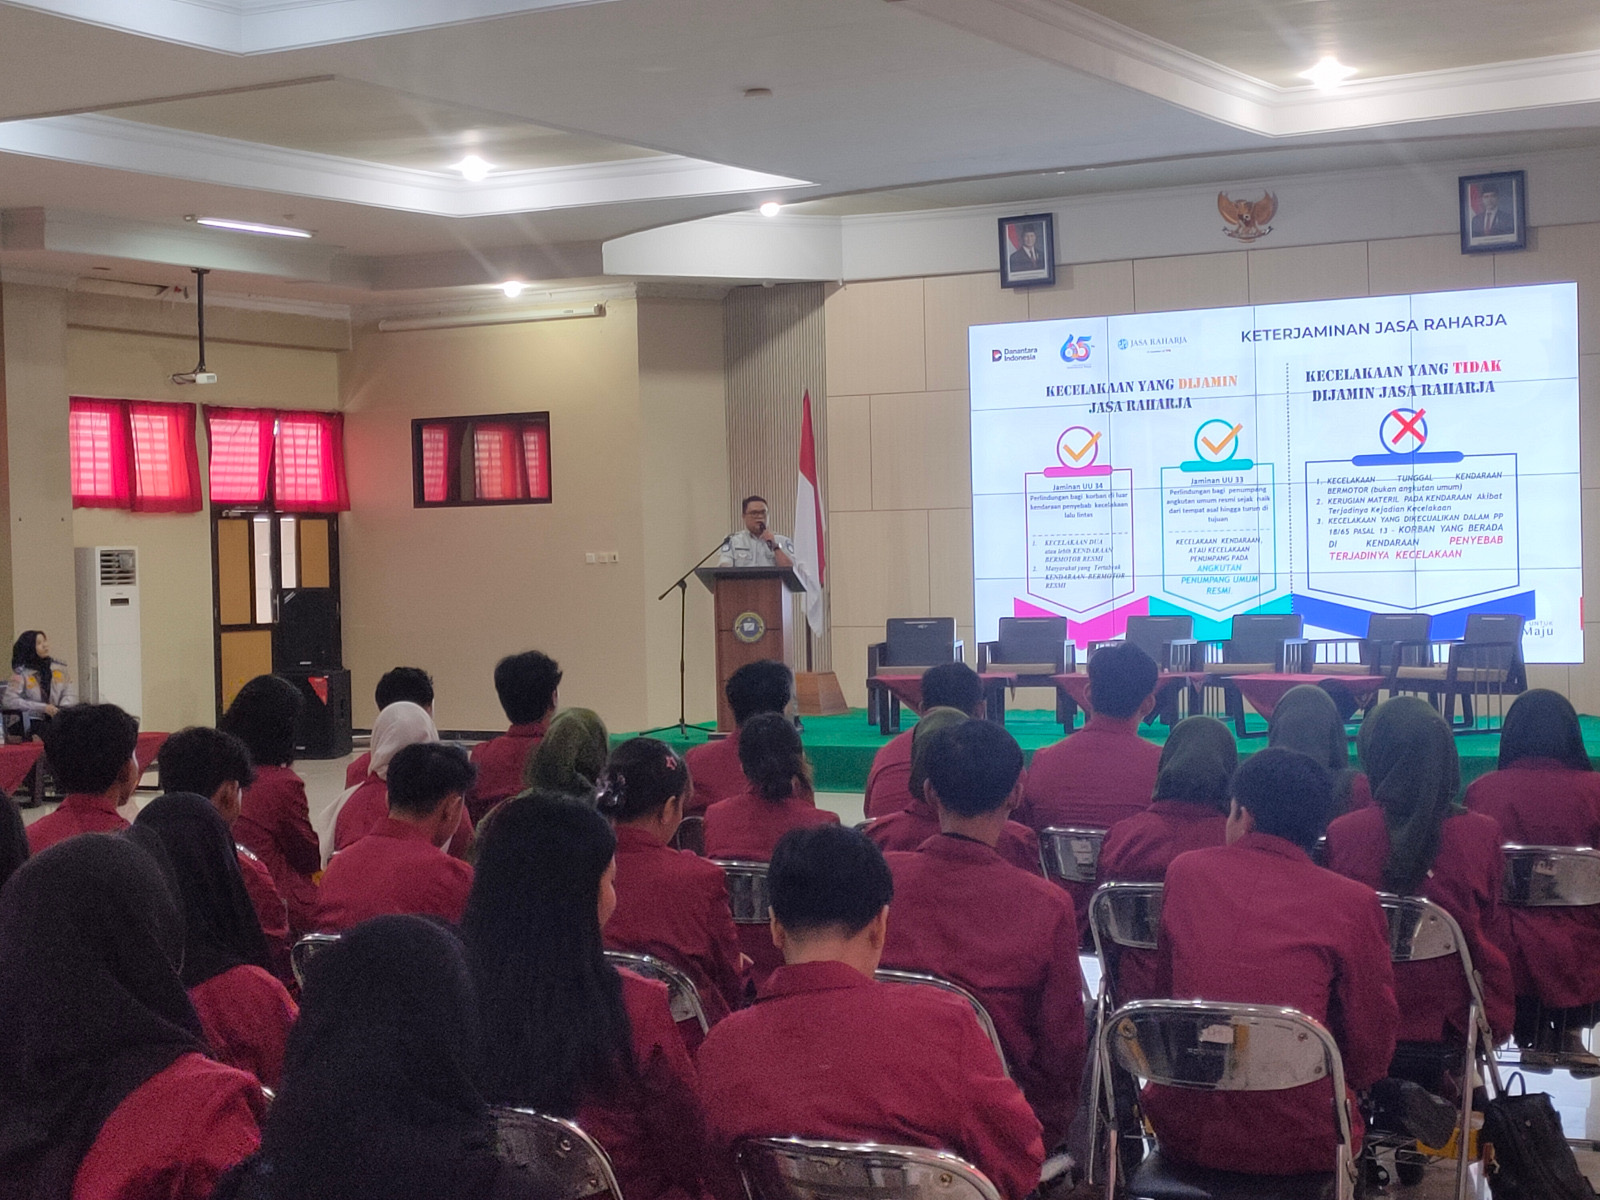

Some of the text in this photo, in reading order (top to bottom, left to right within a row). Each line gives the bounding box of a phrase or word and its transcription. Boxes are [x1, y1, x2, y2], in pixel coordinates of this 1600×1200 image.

[1241, 314, 1507, 343] KETERJAMINAN JASA RAHARJA
[1130, 336, 1188, 348] JASA RAHARJA
[1306, 360, 1501, 382] KECELAKAAN YANG TIDAK
[1046, 375, 1238, 397] KECELAKAAN YANG DIJAMIN
[1312, 381, 1495, 402] DIJAMIN JASA RAHARJA
[1089, 397, 1192, 414] JASA RAHARJA
[1399, 485, 1434, 493] angkutan
[1371, 506, 1404, 514] Kejadian
[1399, 525, 1435, 533] KORBAN
[1366, 539, 1419, 547] KENDARAAN
[1449, 536, 1503, 545] PENYEBAB
[1330, 550, 1462, 560] TERJADINYA KECELAKAAN
[1181, 576, 1230, 584] PENUMPANG
[1523, 626, 1554, 638] Maju
